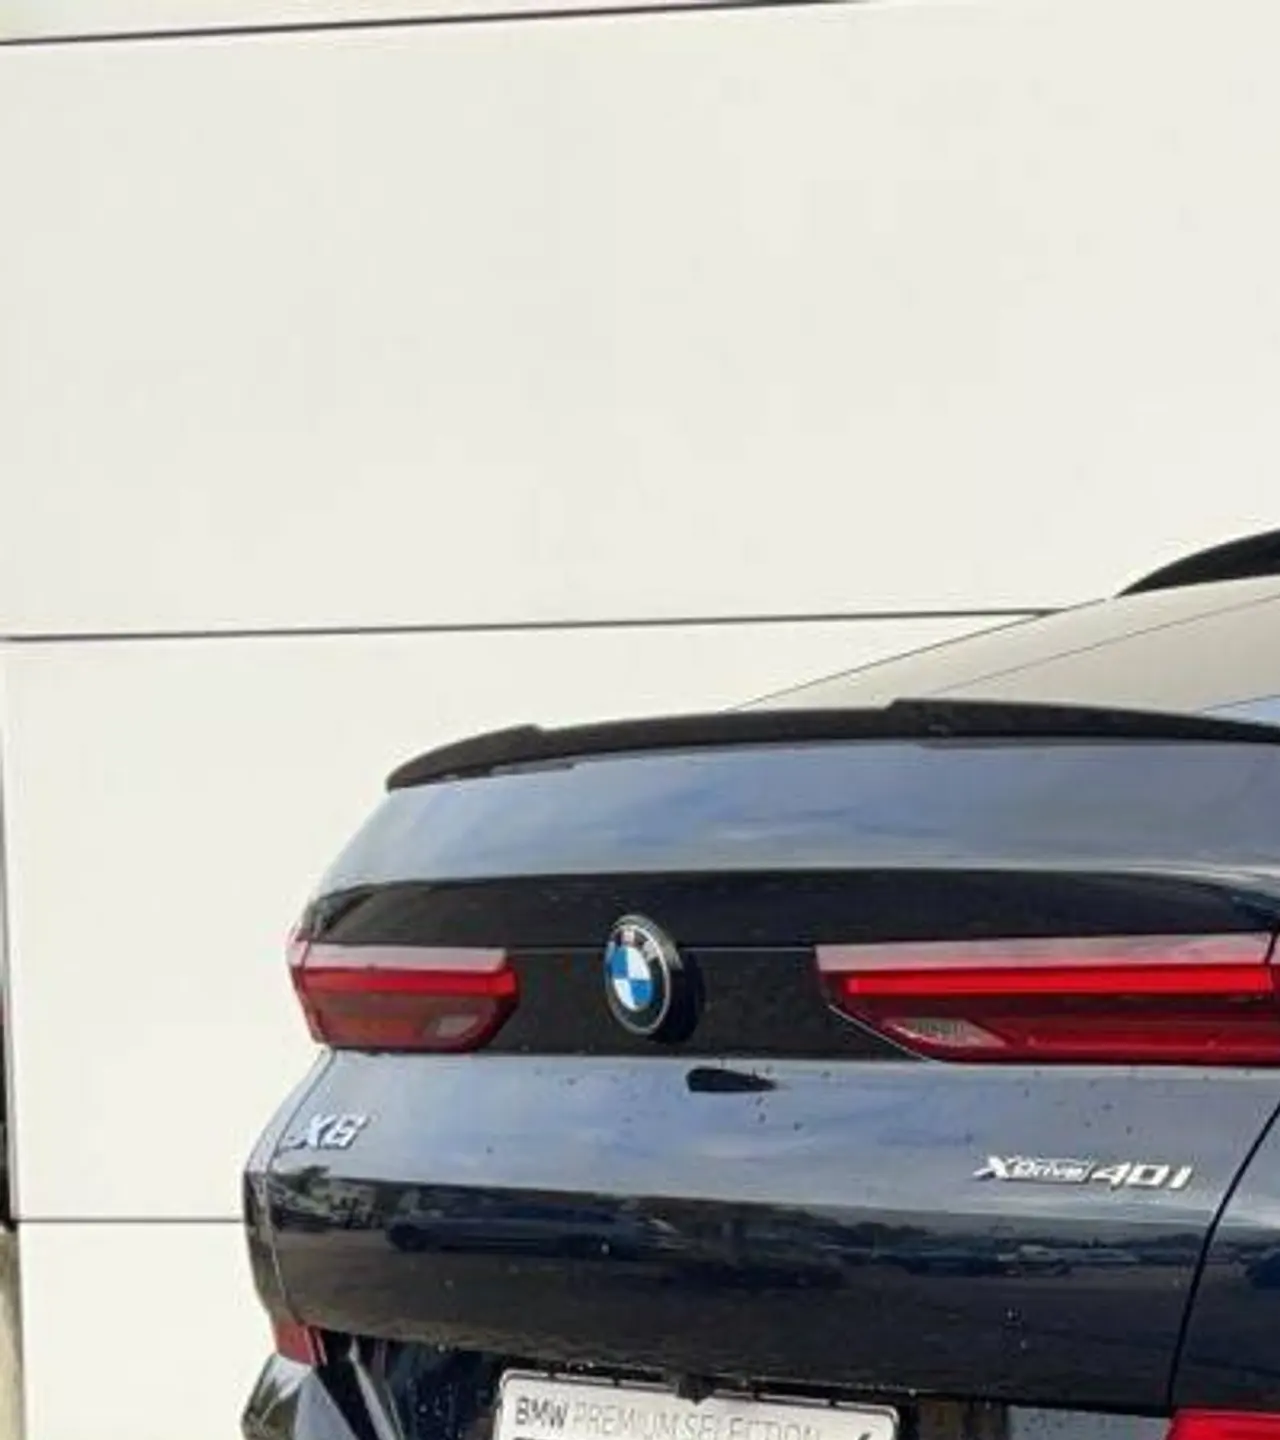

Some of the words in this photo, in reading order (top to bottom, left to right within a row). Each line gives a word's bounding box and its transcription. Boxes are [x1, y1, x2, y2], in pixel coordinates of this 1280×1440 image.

[285, 1113, 370, 1150] X6
[515, 1397, 568, 1429] BMW
[571, 1402, 679, 1440] PREMIUM
